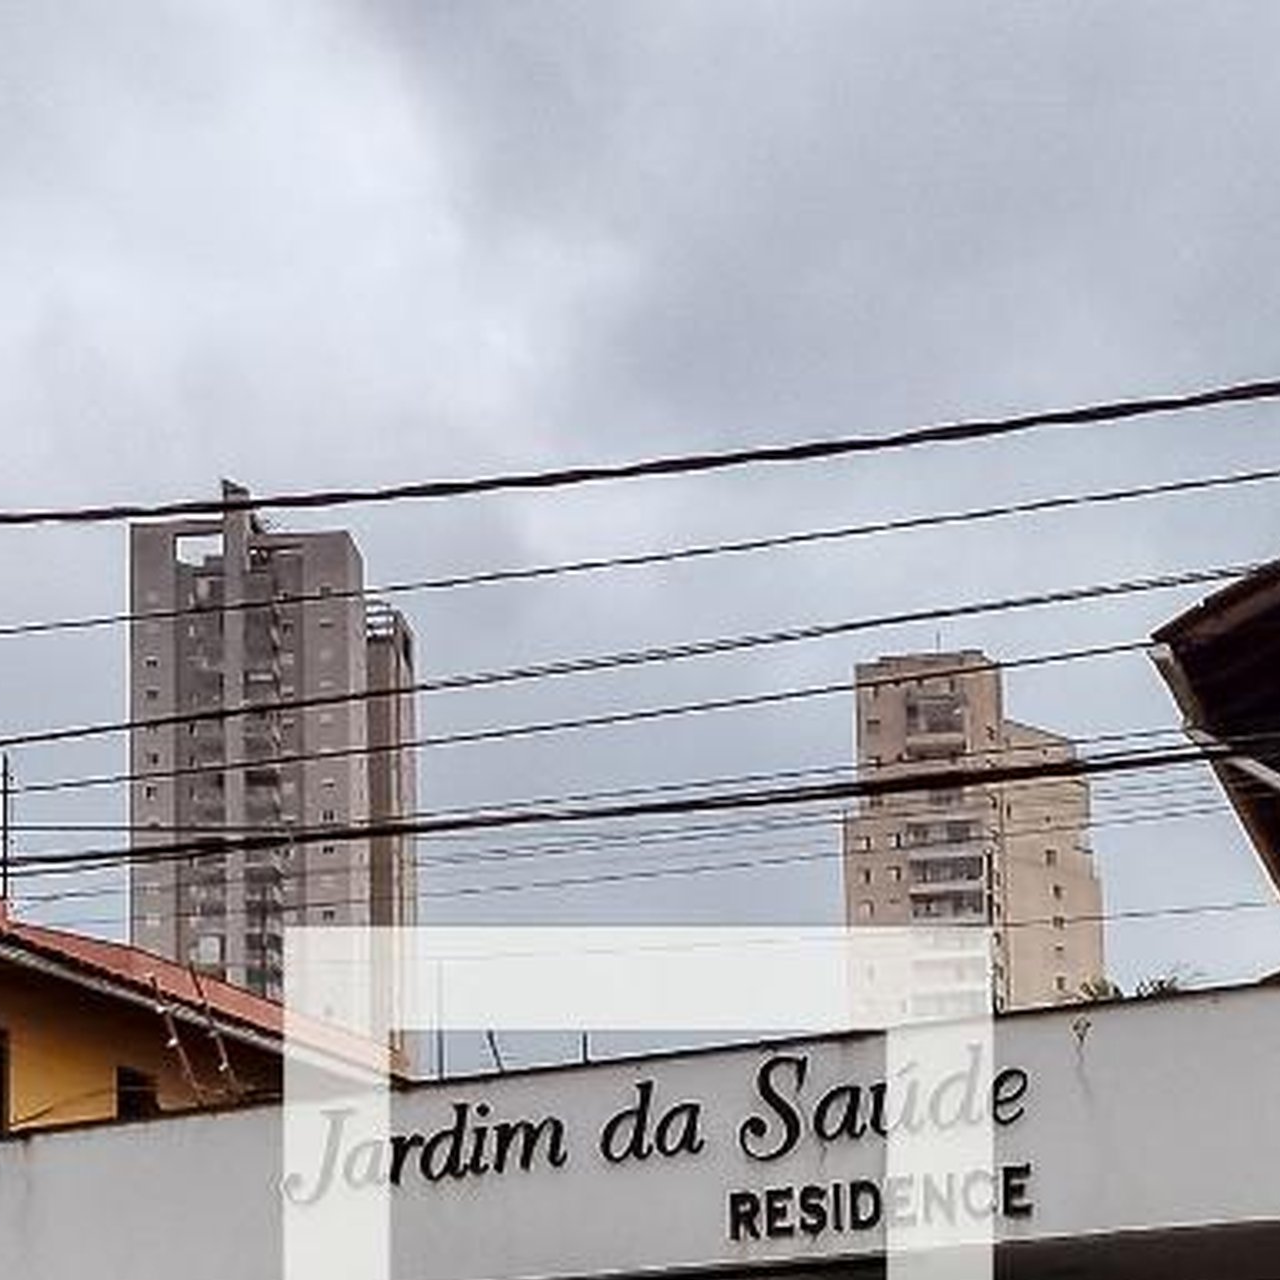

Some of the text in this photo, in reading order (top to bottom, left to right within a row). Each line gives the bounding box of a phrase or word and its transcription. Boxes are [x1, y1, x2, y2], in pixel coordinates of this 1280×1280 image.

[284, 1043, 1028, 1205] Jardim da Saúde
[728, 1163, 1034, 1241] RESIDENCE
